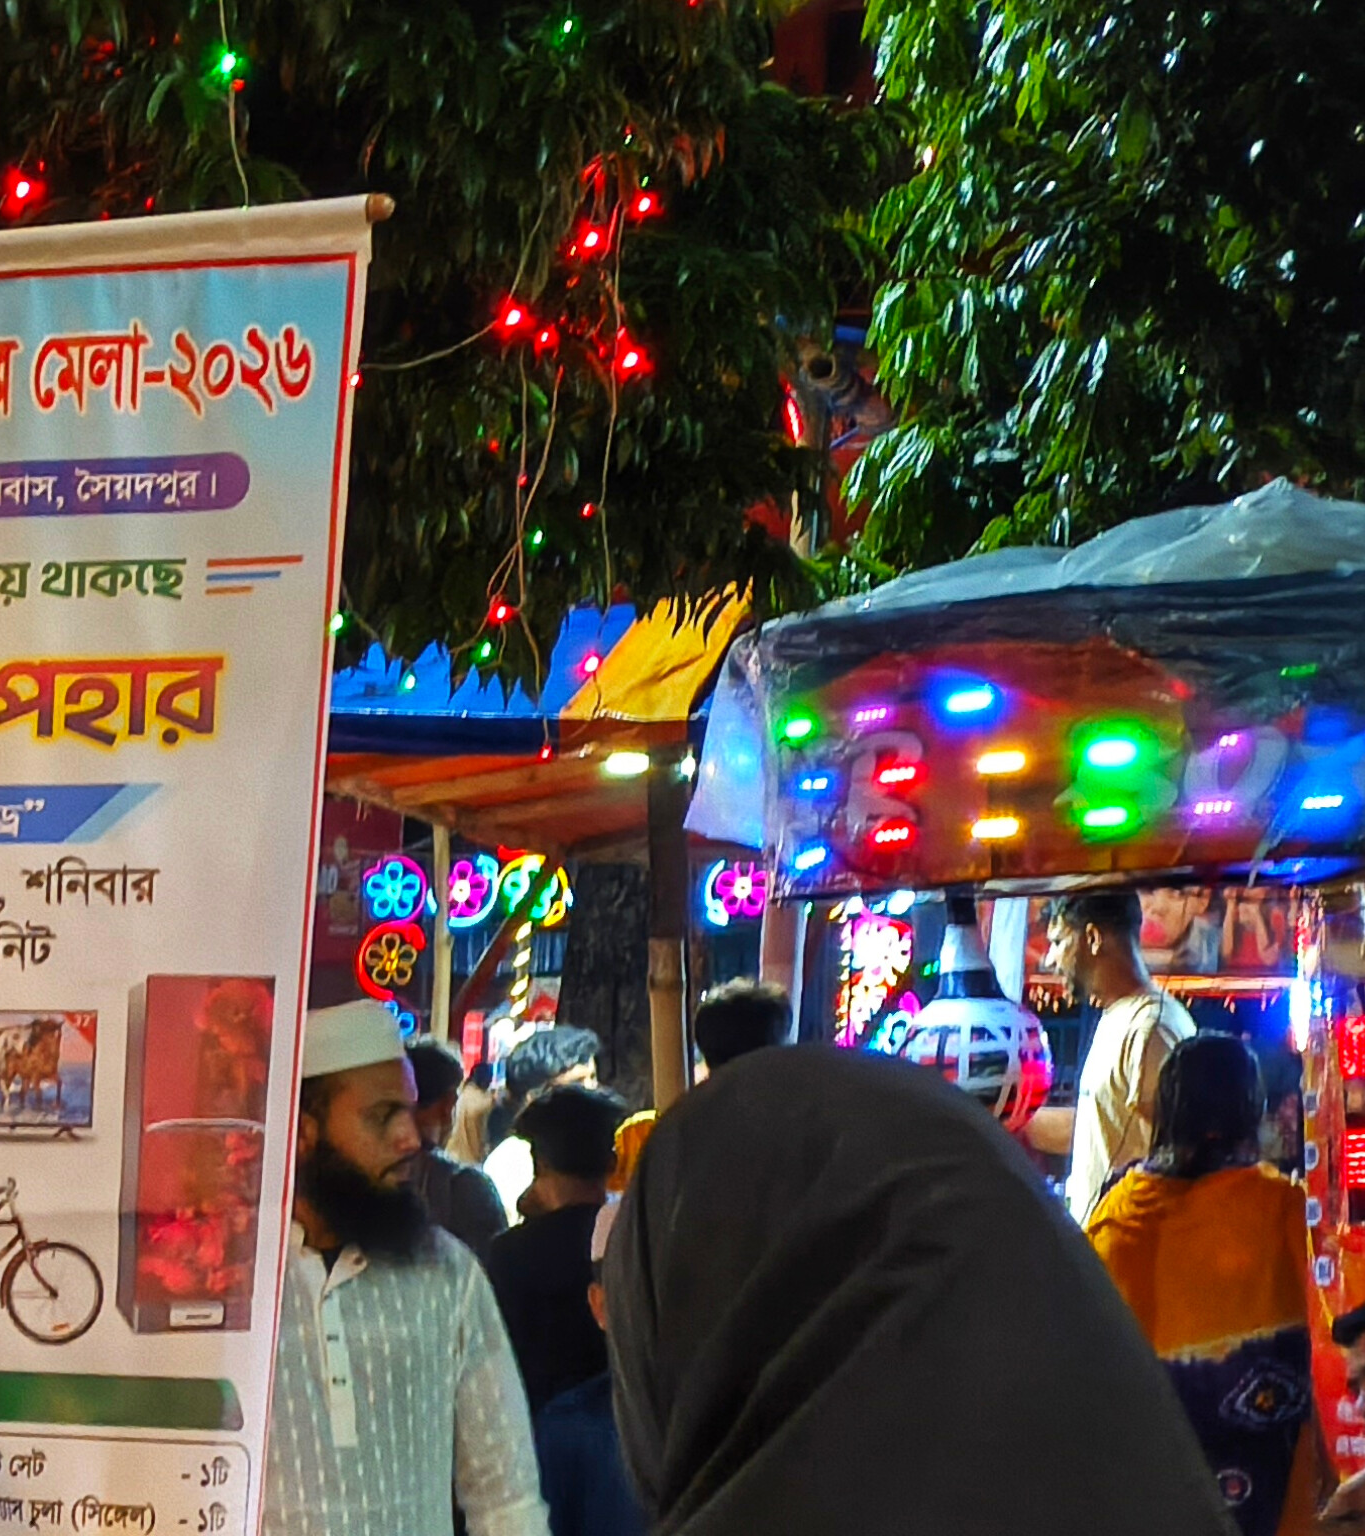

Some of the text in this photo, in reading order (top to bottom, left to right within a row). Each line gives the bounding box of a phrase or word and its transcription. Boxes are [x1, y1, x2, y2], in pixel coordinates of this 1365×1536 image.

[35, 322, 312, 416] মেলা-২০২৬
[40, 557, 187, 601] থাকছে
[21, 855, 161, 907] শনিবার
[9, 1447, 47, 1480] সেট
